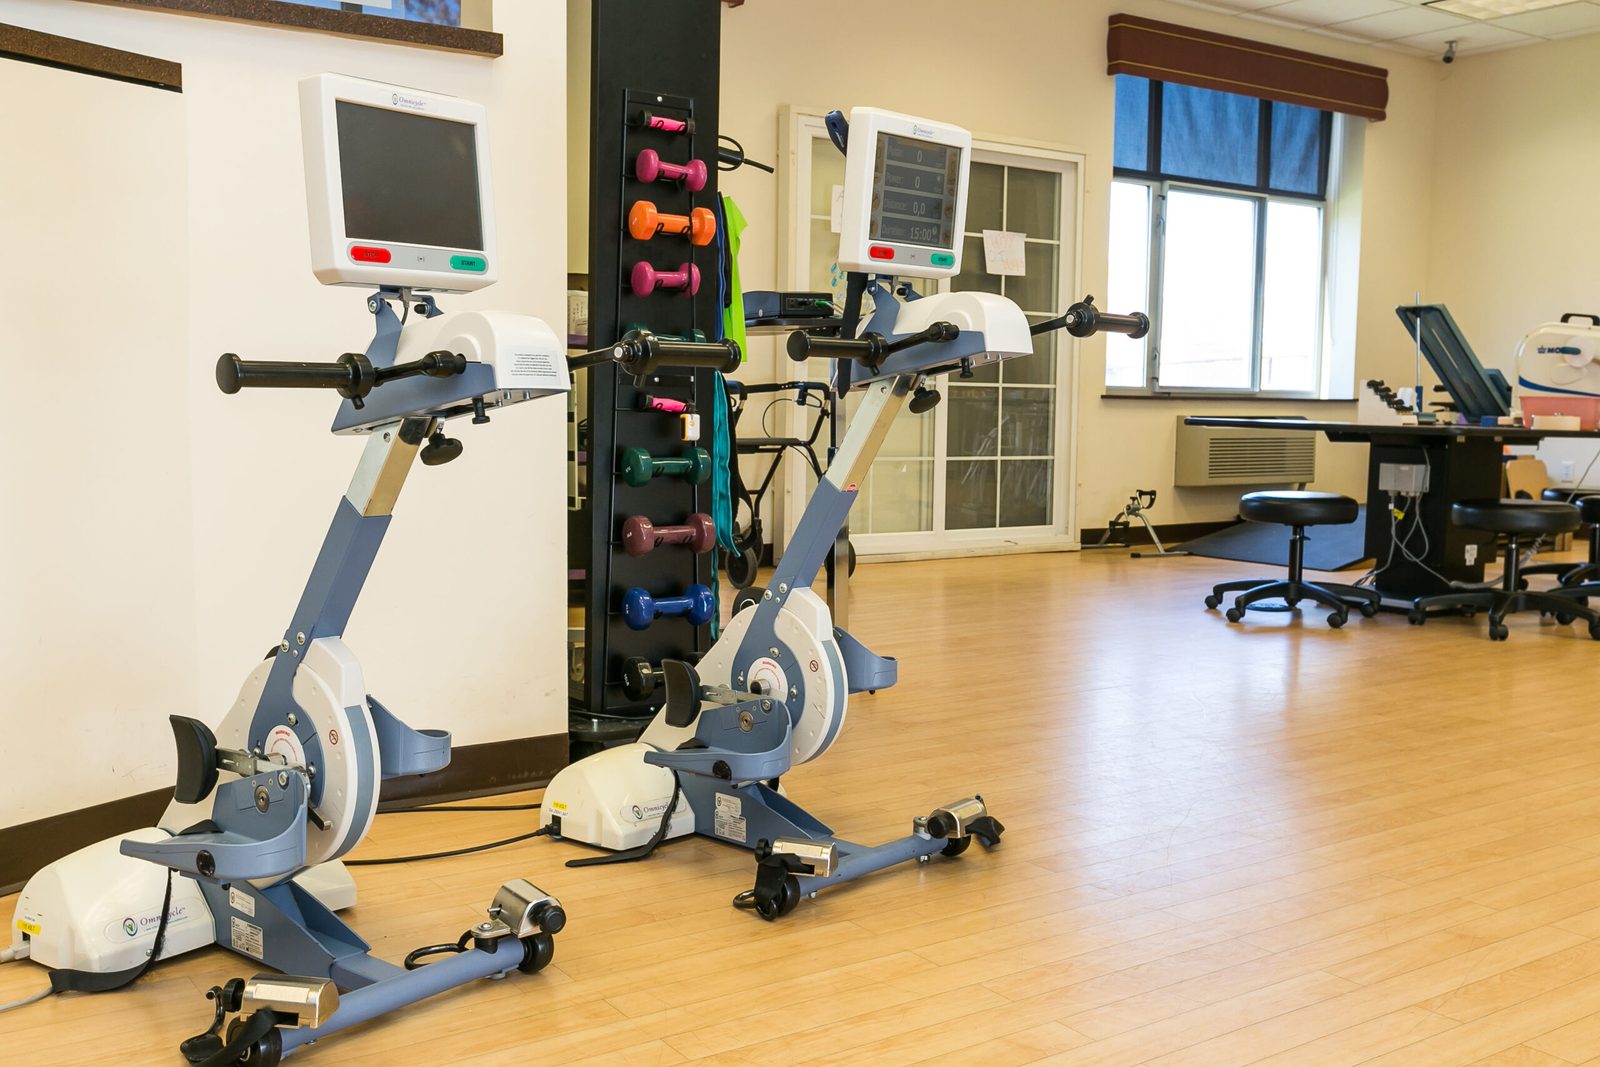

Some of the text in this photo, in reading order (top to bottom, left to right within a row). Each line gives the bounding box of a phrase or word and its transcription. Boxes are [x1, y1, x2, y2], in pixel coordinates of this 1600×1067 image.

[917, 150, 922, 162] 0
[915, 176, 920, 188] 0
[911, 227, 931, 241] 15:00
[461, 259, 475, 267] START
